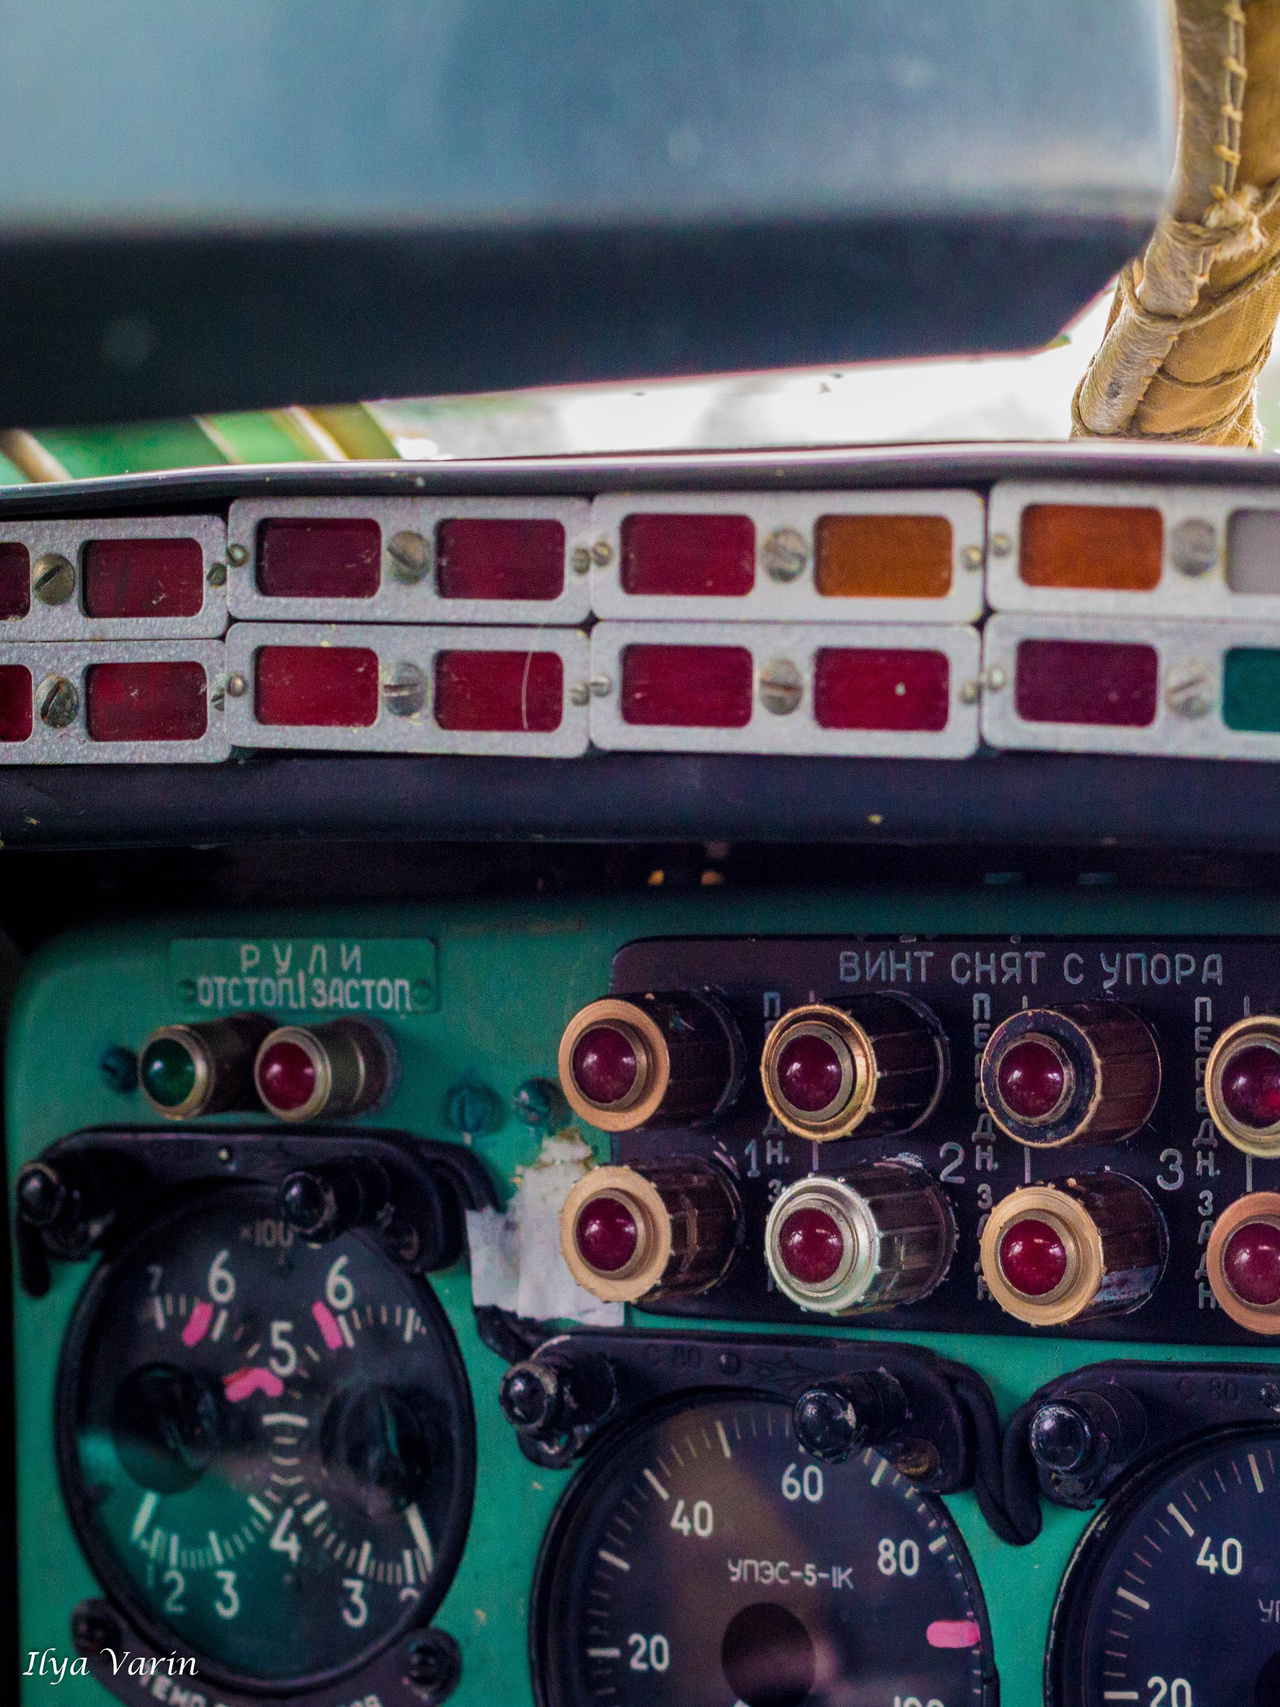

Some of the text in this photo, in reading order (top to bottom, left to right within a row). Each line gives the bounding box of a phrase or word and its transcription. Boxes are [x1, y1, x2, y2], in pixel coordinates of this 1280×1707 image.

[838, 951, 1223, 990] ВИНТ СНЯТ С УПОРА
[744, 1139, 761, 1178] 1
[939, 1142, 966, 1184] 2
[1157, 1148, 1184, 1190] 3
[208, 1250, 236, 1304] 6
[326, 1255, 354, 1309] 6
[268, 1320, 298, 1377] 5
[781, 1464, 825, 1503] 60
[269, 1507, 300, 1563] 4
[670, 1499, 714, 1538] 40
[877, 1537, 920, 1576] 80
[1196, 1536, 1243, 1576] 40
[162, 1569, 187, 1614] 2
[215, 1571, 241, 1619] 3
[341, 1578, 368, 1627] 3
[628, 1633, 670, 1672] 20
